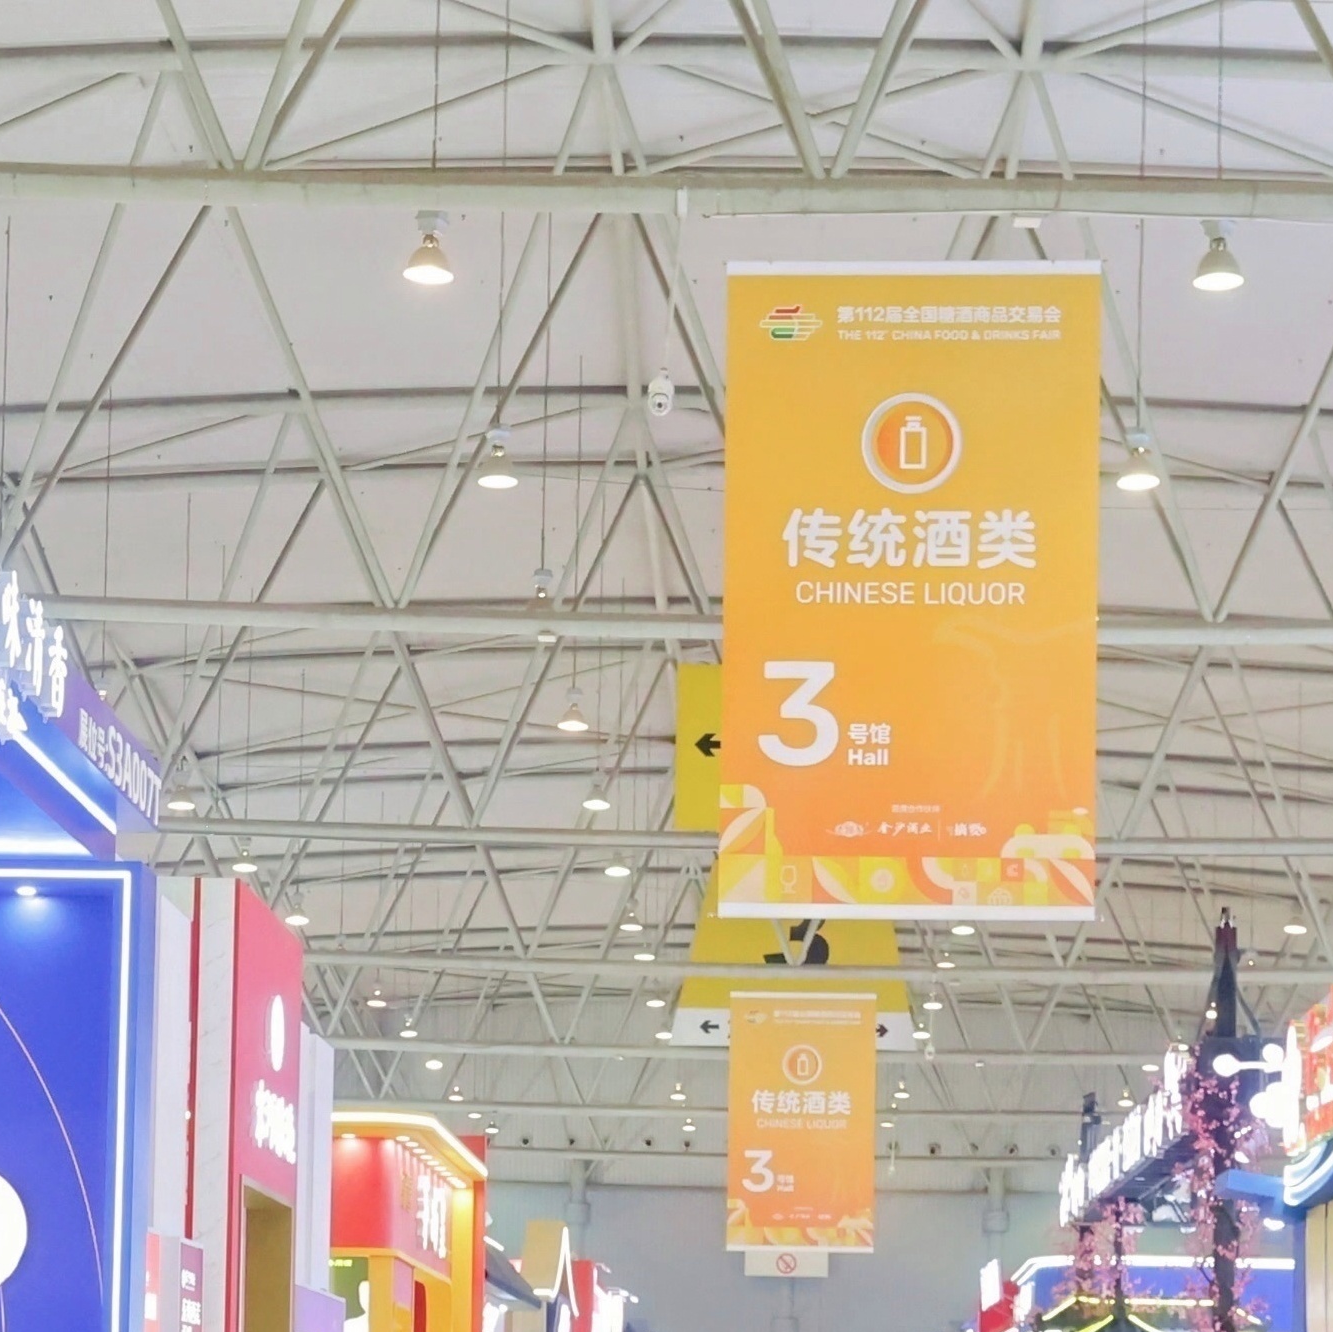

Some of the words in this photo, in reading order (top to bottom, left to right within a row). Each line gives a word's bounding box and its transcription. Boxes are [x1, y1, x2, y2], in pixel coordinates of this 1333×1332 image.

[837, 329, 861, 341] THE
[892, 329, 931, 341] CHINA
[934, 329, 968, 341] FOOD
[971, 329, 980, 341] &
[985, 329, 1029, 341] DRINKS
[1032, 329, 1061, 341] FAIR
[782, 508, 1037, 570] 传统酒类
[795, 582, 915, 605] CHINESE
[923, 582, 1025, 607] LIQUOR
[757, 660, 839, 767] 3
[848, 722, 891, 746] 号馆
[848, 748, 889, 766] Hall
[751, 1089, 852, 1115] 传统酒类
[756, 1118, 803, 1129] CHINESE
[805, 1118, 848, 1130] LIQUOR
[742, 1149, 775, 1193] 3
